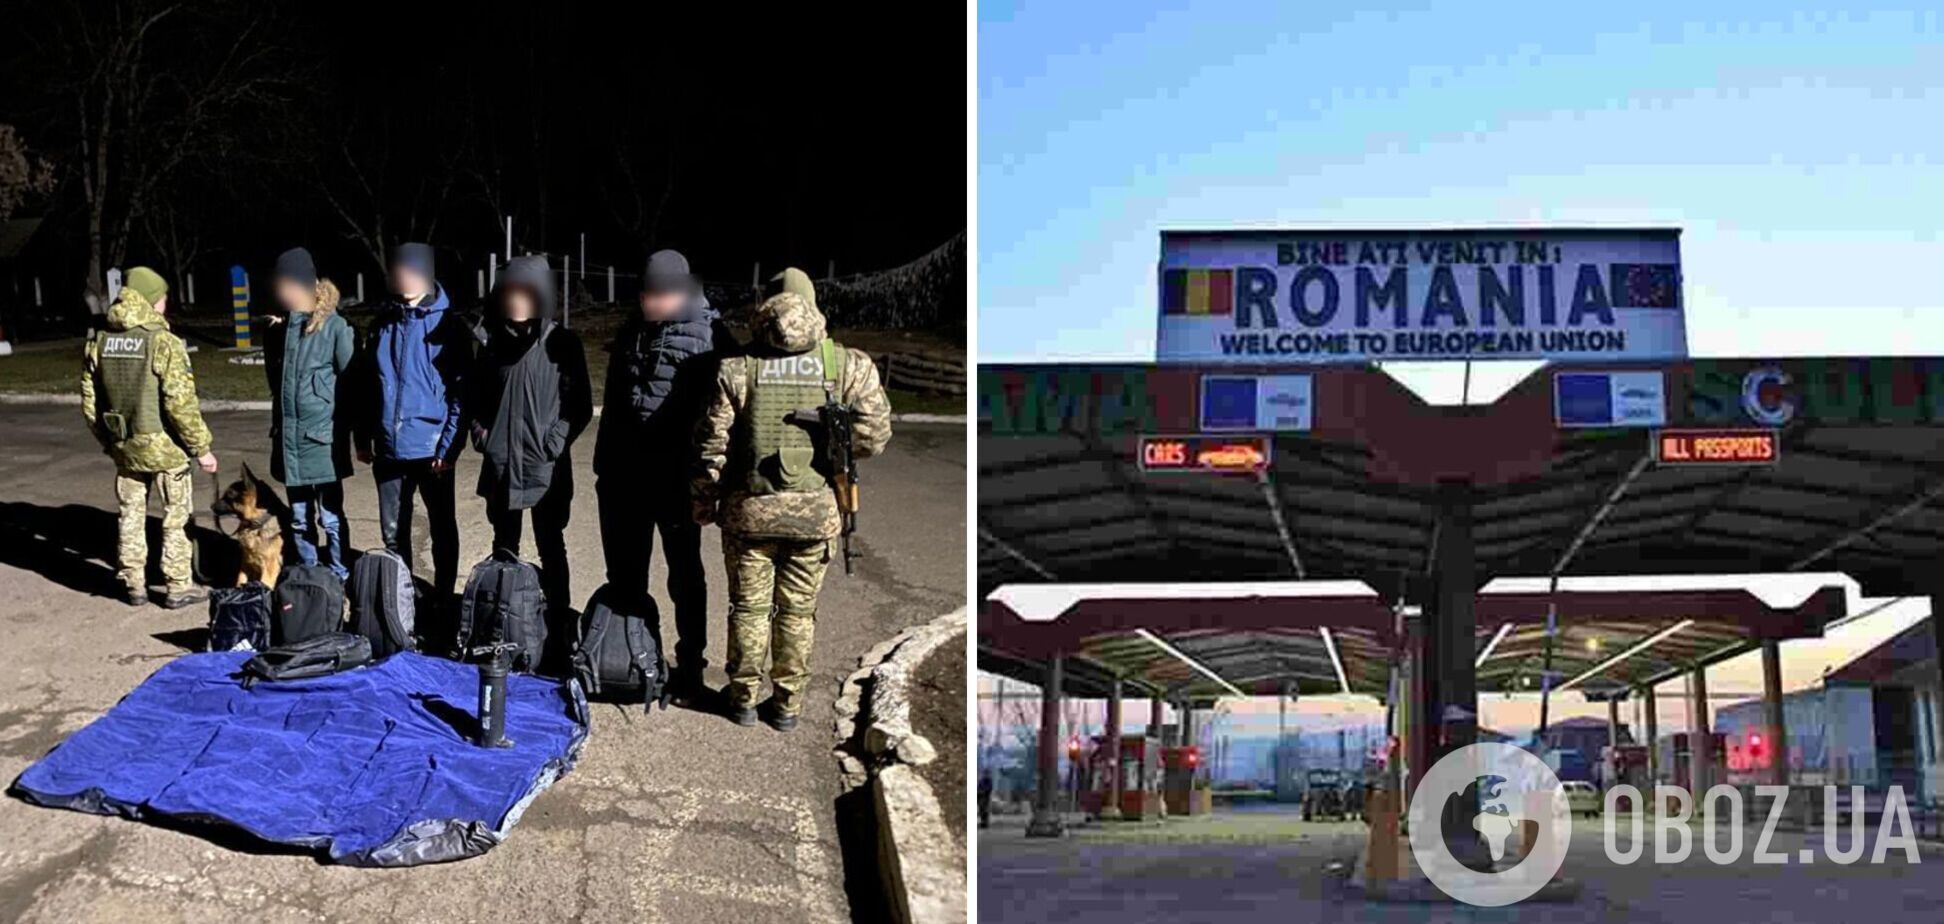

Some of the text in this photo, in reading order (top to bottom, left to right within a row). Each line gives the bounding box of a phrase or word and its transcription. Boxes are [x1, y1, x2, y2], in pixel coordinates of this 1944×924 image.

[1277, 242, 1349, 265] BINE
[1414, 241, 1506, 264] VENIT
[1235, 264, 1616, 328] ROMANIA
[103, 336, 144, 353] ДПСУ
[1220, 330, 1626, 355] WELCOME TO EUROPEAN UNION
[762, 355, 824, 377] ДПСУ
[1144, 443, 1185, 465] CARS
[1694, 437, 1772, 459] PASSPORTS
